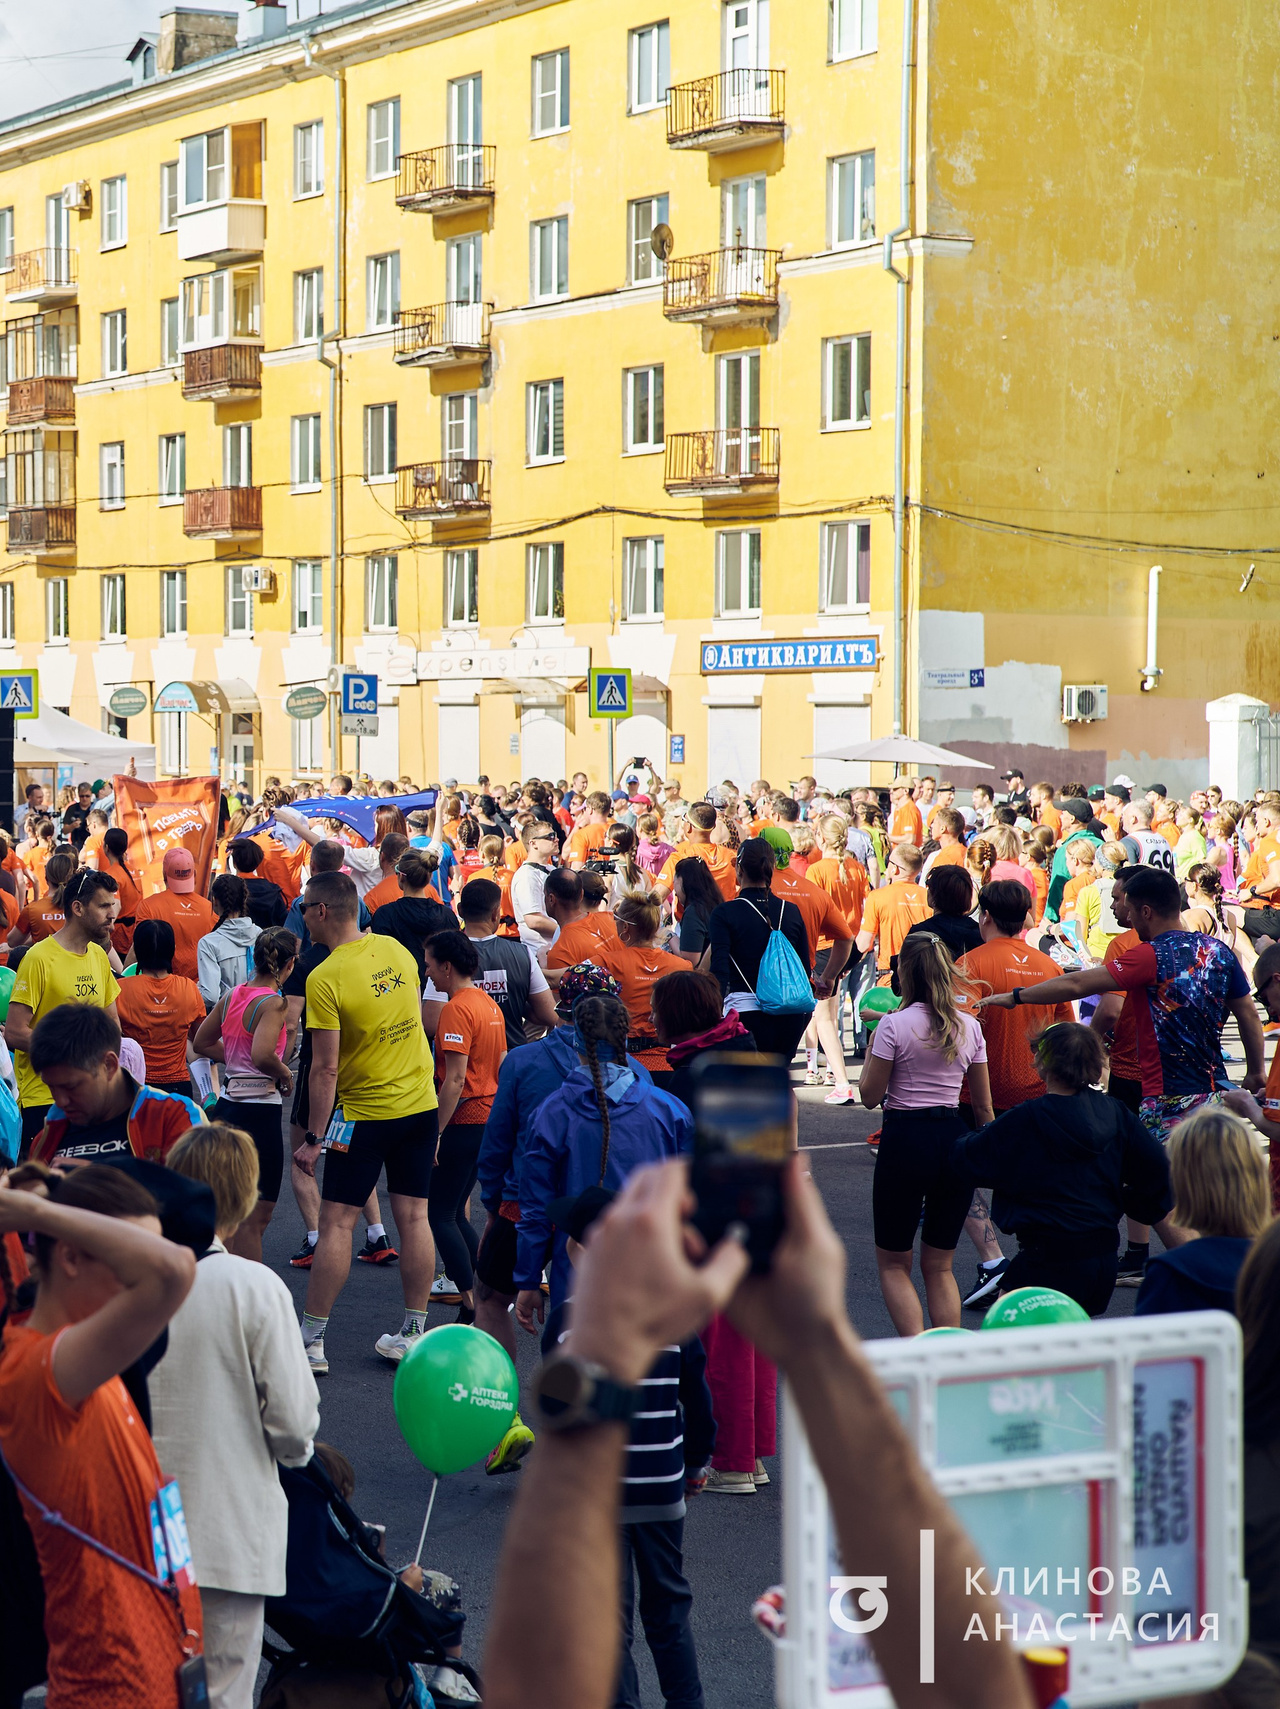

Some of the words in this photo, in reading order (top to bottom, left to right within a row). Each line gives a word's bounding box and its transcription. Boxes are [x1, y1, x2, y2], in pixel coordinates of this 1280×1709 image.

[349, 678, 369, 710] P
[156, 838, 168, 850] В
[167, 820, 203, 840] ТВЕРЬ
[474, 981, 505, 991] MOEX
[1018, 1294, 1056, 1308] АПТЕКИ
[1021, 1299, 1070, 1314] ГОРЗДРАВ
[471, 1386, 509, 1401] АПТЕКИ
[469, 1397, 514, 1411] ГОРЗДРАВ
